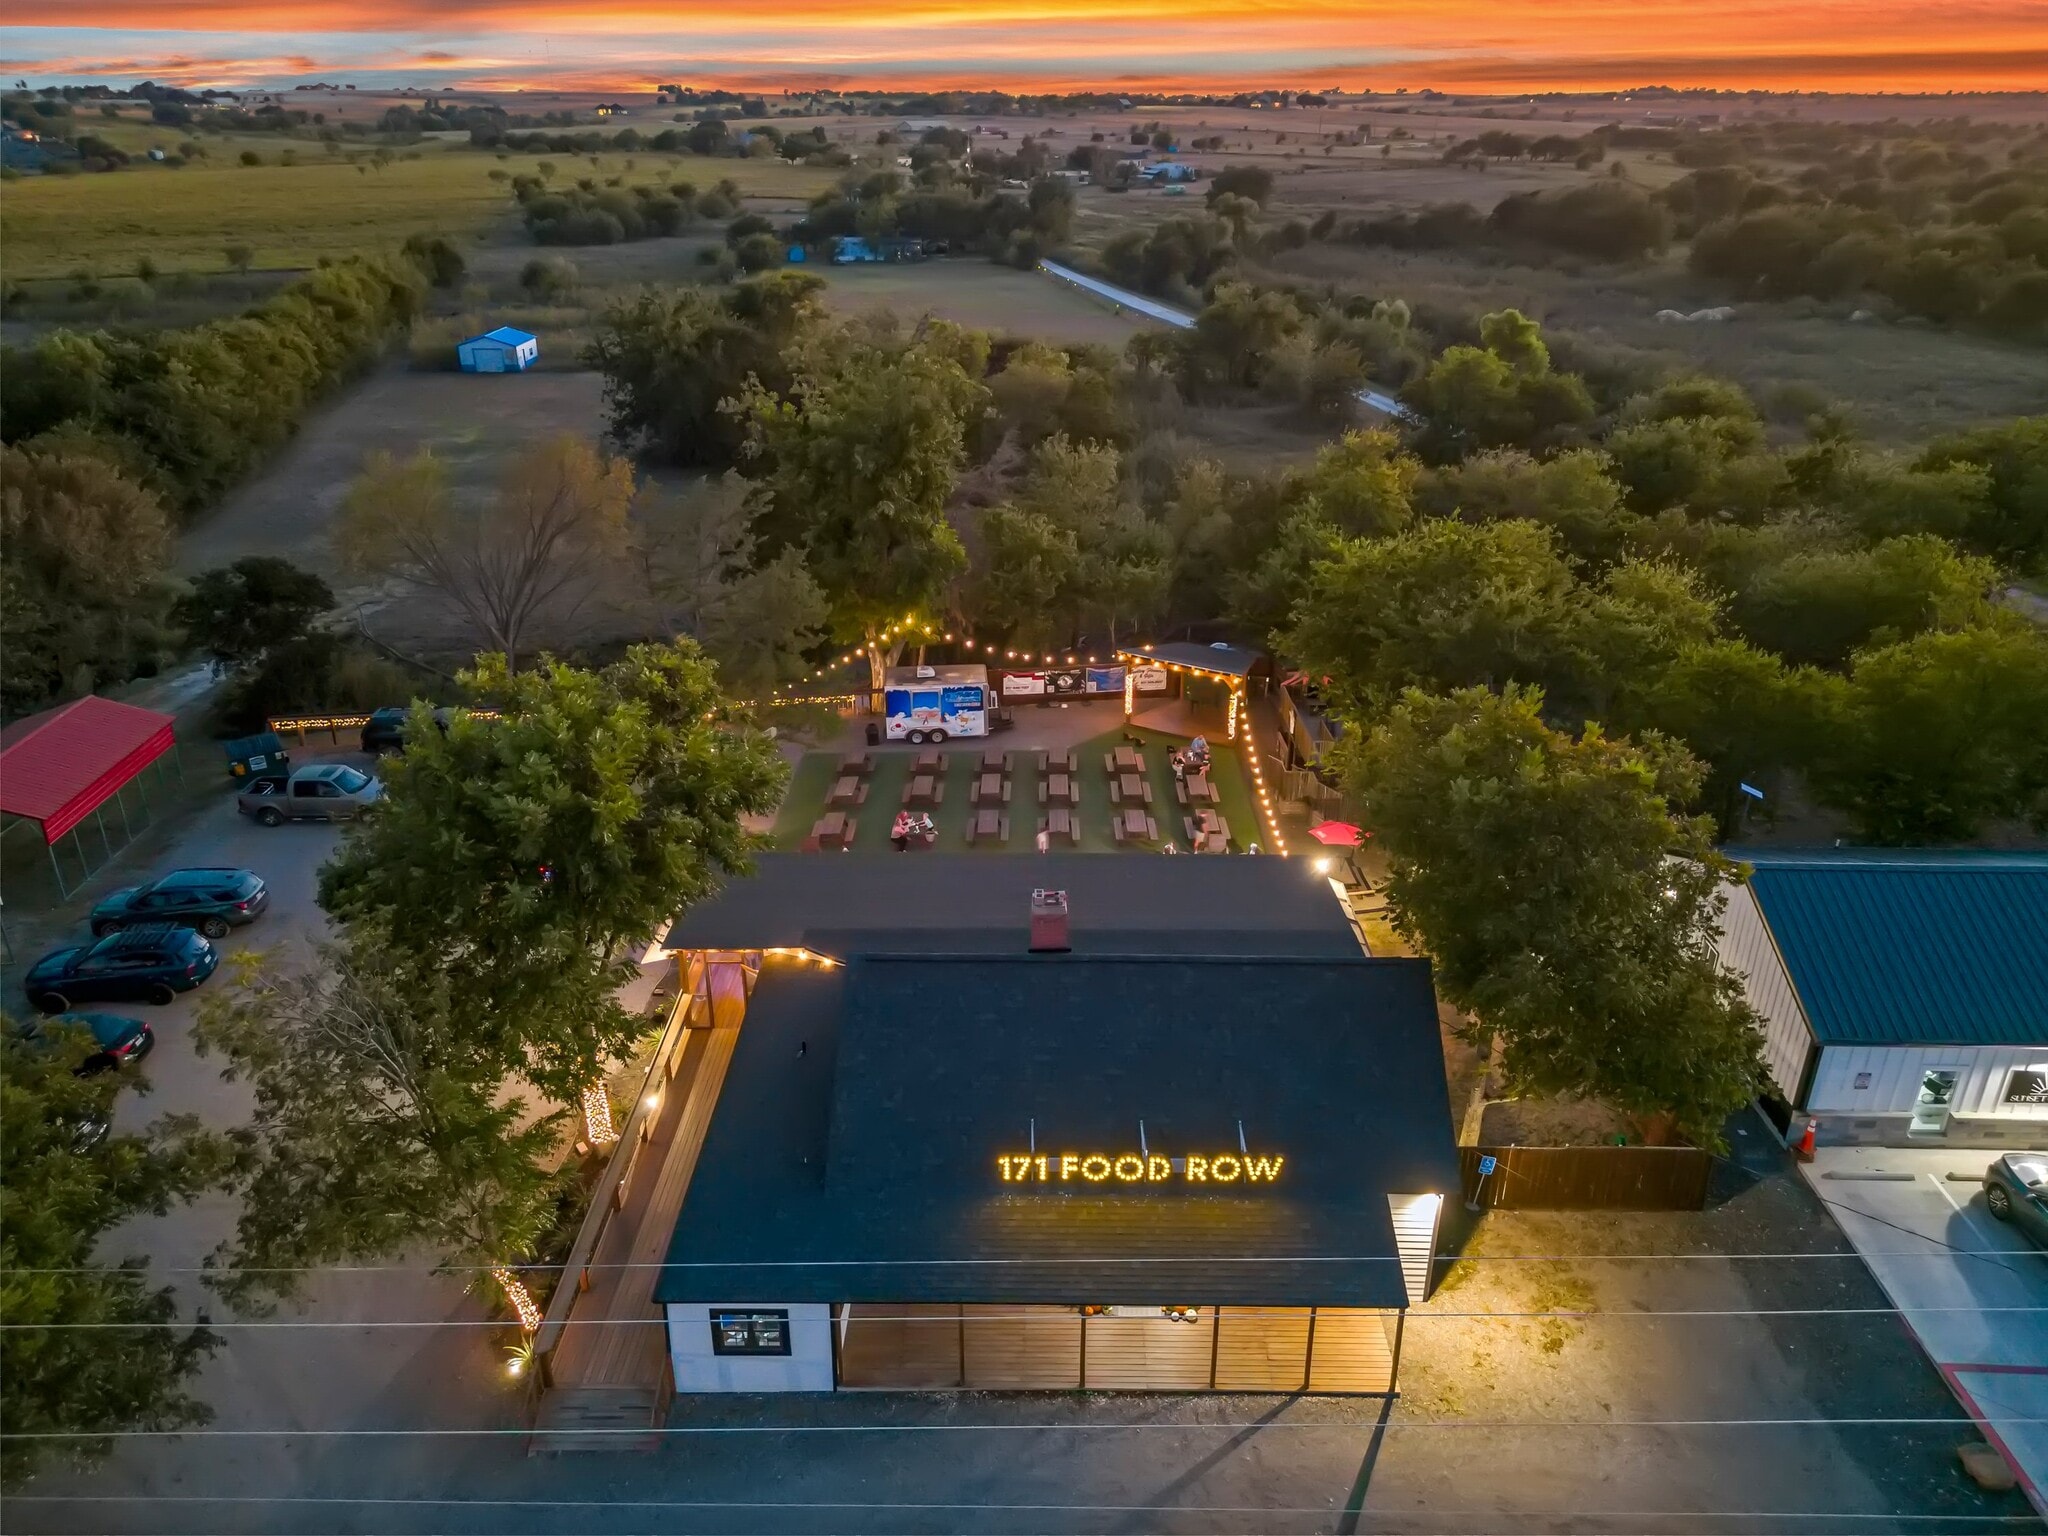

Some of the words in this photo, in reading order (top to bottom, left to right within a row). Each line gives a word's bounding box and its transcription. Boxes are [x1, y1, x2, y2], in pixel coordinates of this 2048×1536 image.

[997, 1155, 1049, 1182] 171
[1060, 1155, 1172, 1182] FOOD
[1186, 1155, 1285, 1182] ROW
